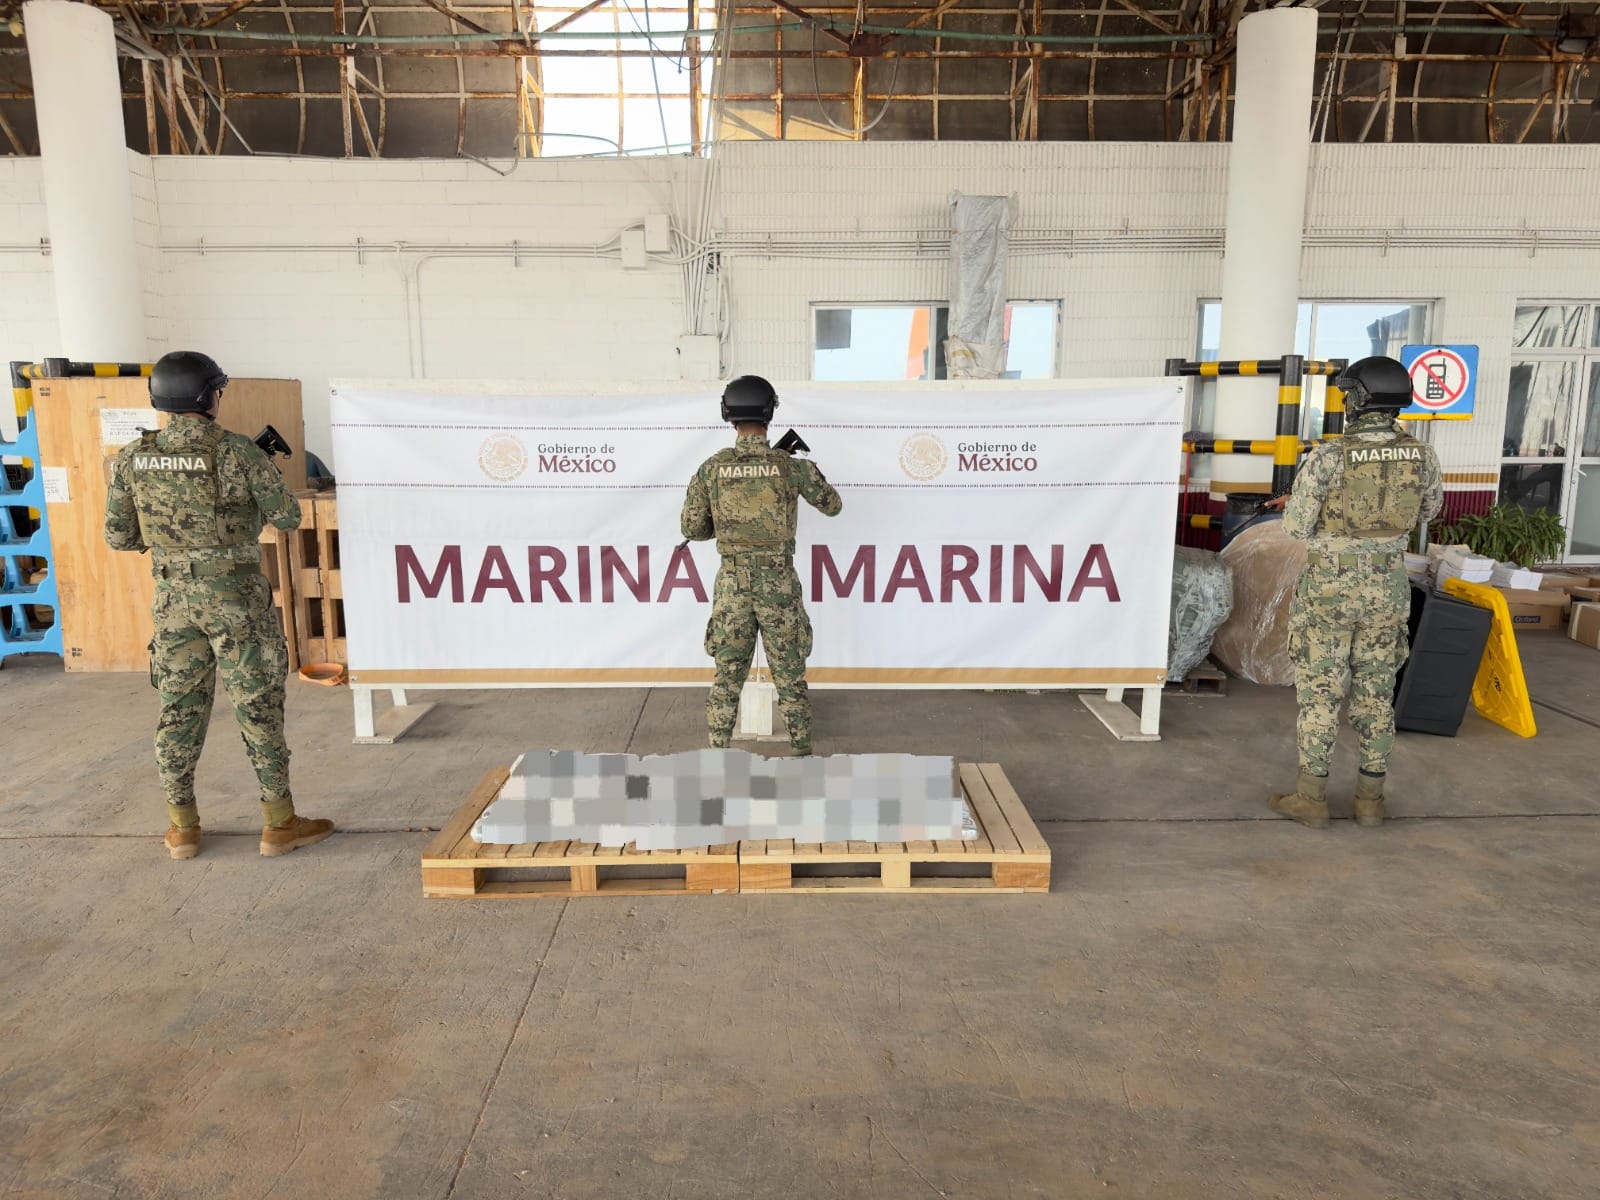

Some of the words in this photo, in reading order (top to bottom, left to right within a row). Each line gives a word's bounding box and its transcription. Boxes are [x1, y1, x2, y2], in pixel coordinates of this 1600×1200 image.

[537, 443, 597, 454] Gobierno
[600, 443, 616, 454] de
[957, 442, 1018, 452] Gobierno
[1021, 441, 1037, 452] de
[958, 452, 1038, 472] México
[1351, 447, 1422, 462] MARINA
[135, 456, 207, 471] MARINA
[538, 454, 617, 473] México
[719, 464, 781, 478] MARINA
[396, 545, 709, 604] MARINA
[811, 544, 1121, 604] MARINA
